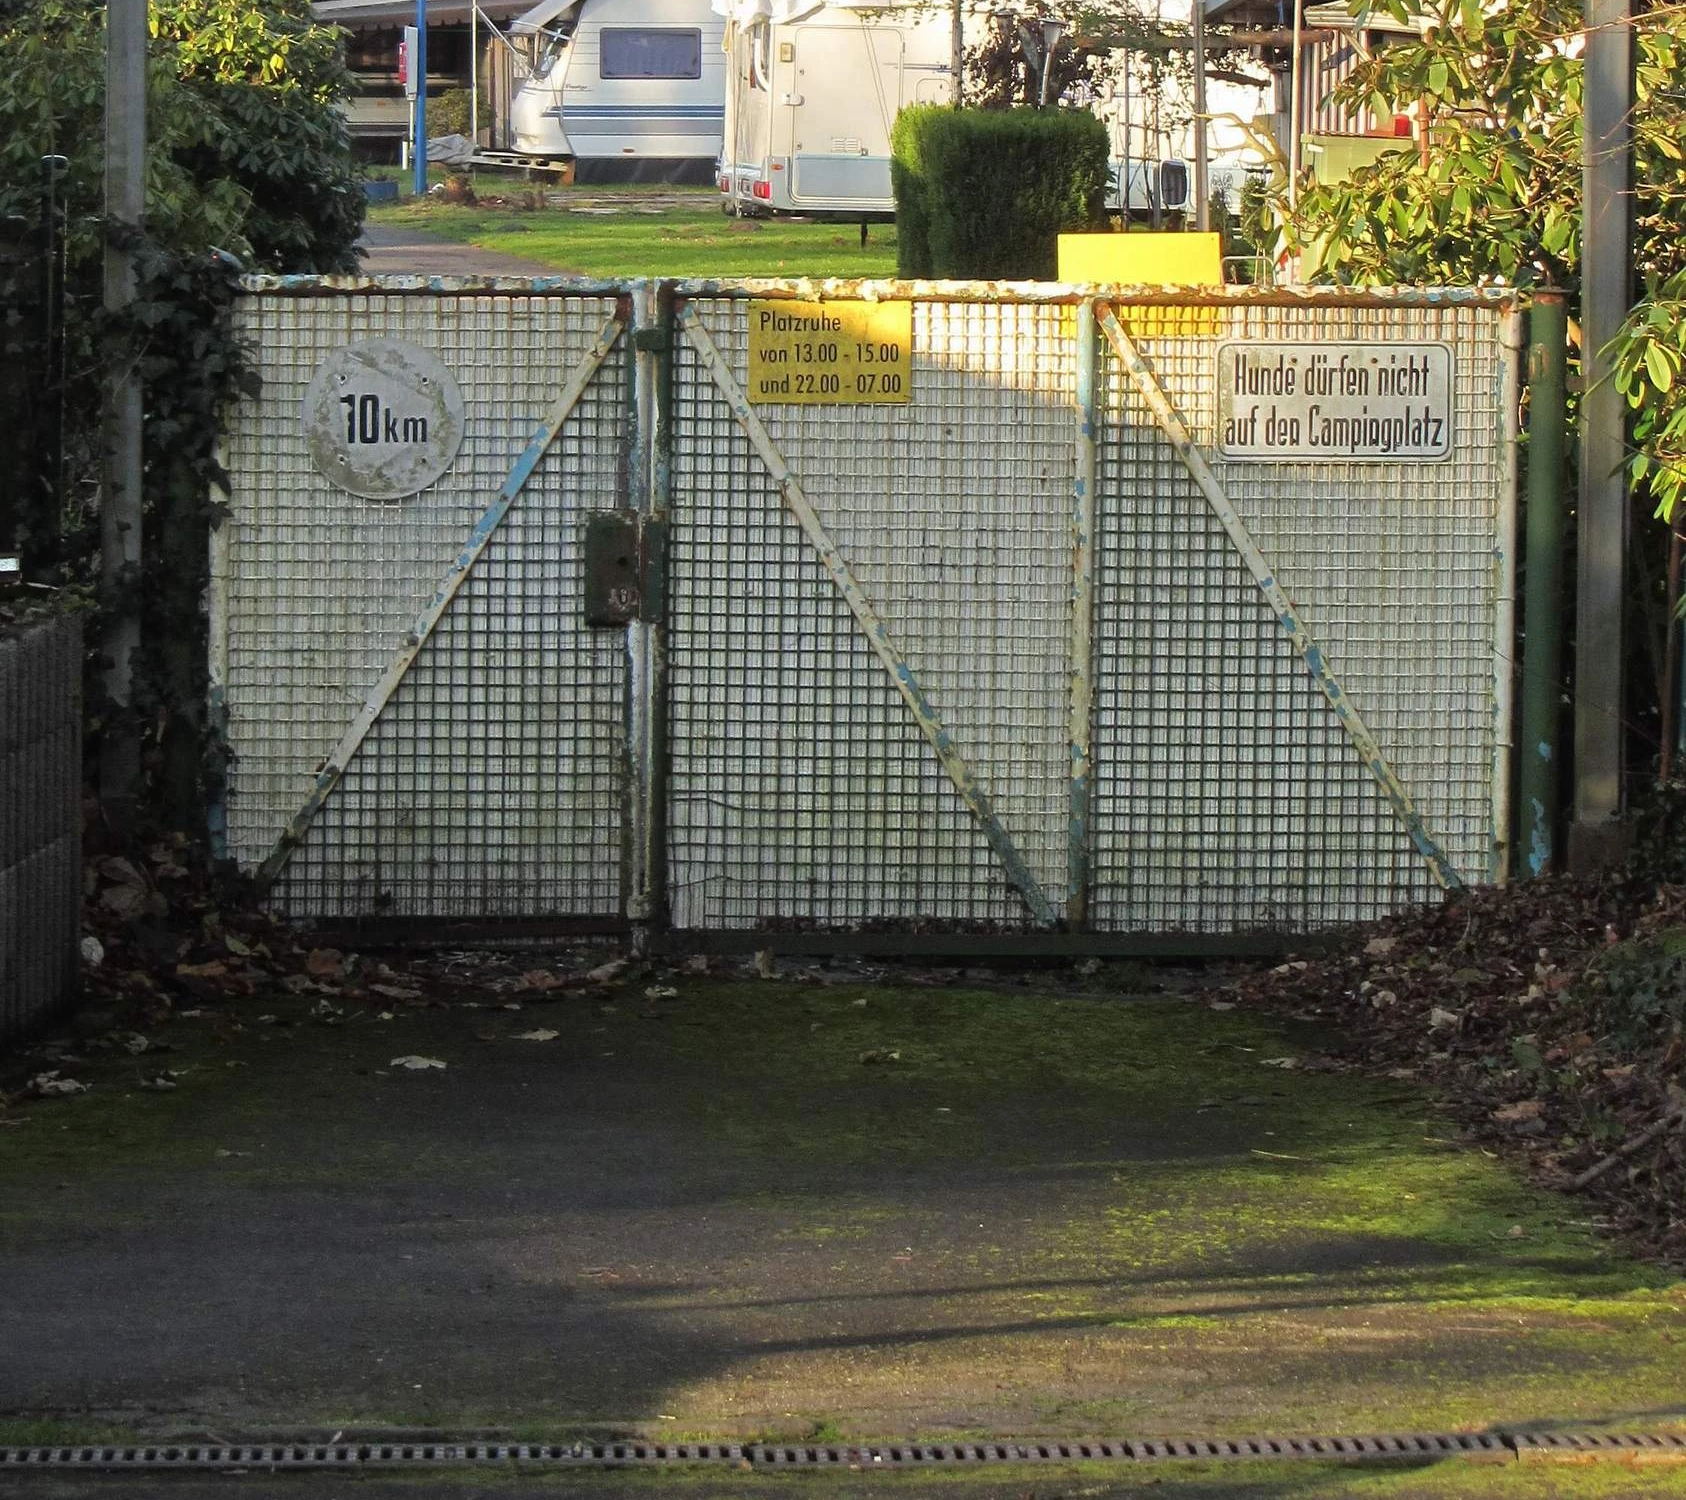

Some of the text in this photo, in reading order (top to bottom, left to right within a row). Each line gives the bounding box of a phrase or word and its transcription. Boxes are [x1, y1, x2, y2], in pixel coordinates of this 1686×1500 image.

[760, 311, 841, 332] Platzruhe
[760, 349, 788, 363] von
[794, 343, 838, 363] 13.00
[856, 343, 899, 363] 15.00
[760, 373, 790, 393] und
[795, 373, 840, 393] 22.00
[856, 373, 901, 393] 07.00
[1234, 354, 1430, 397] Hunde dürfen nicht
[1225, 404, 1444, 453] auf den Campingplatz
